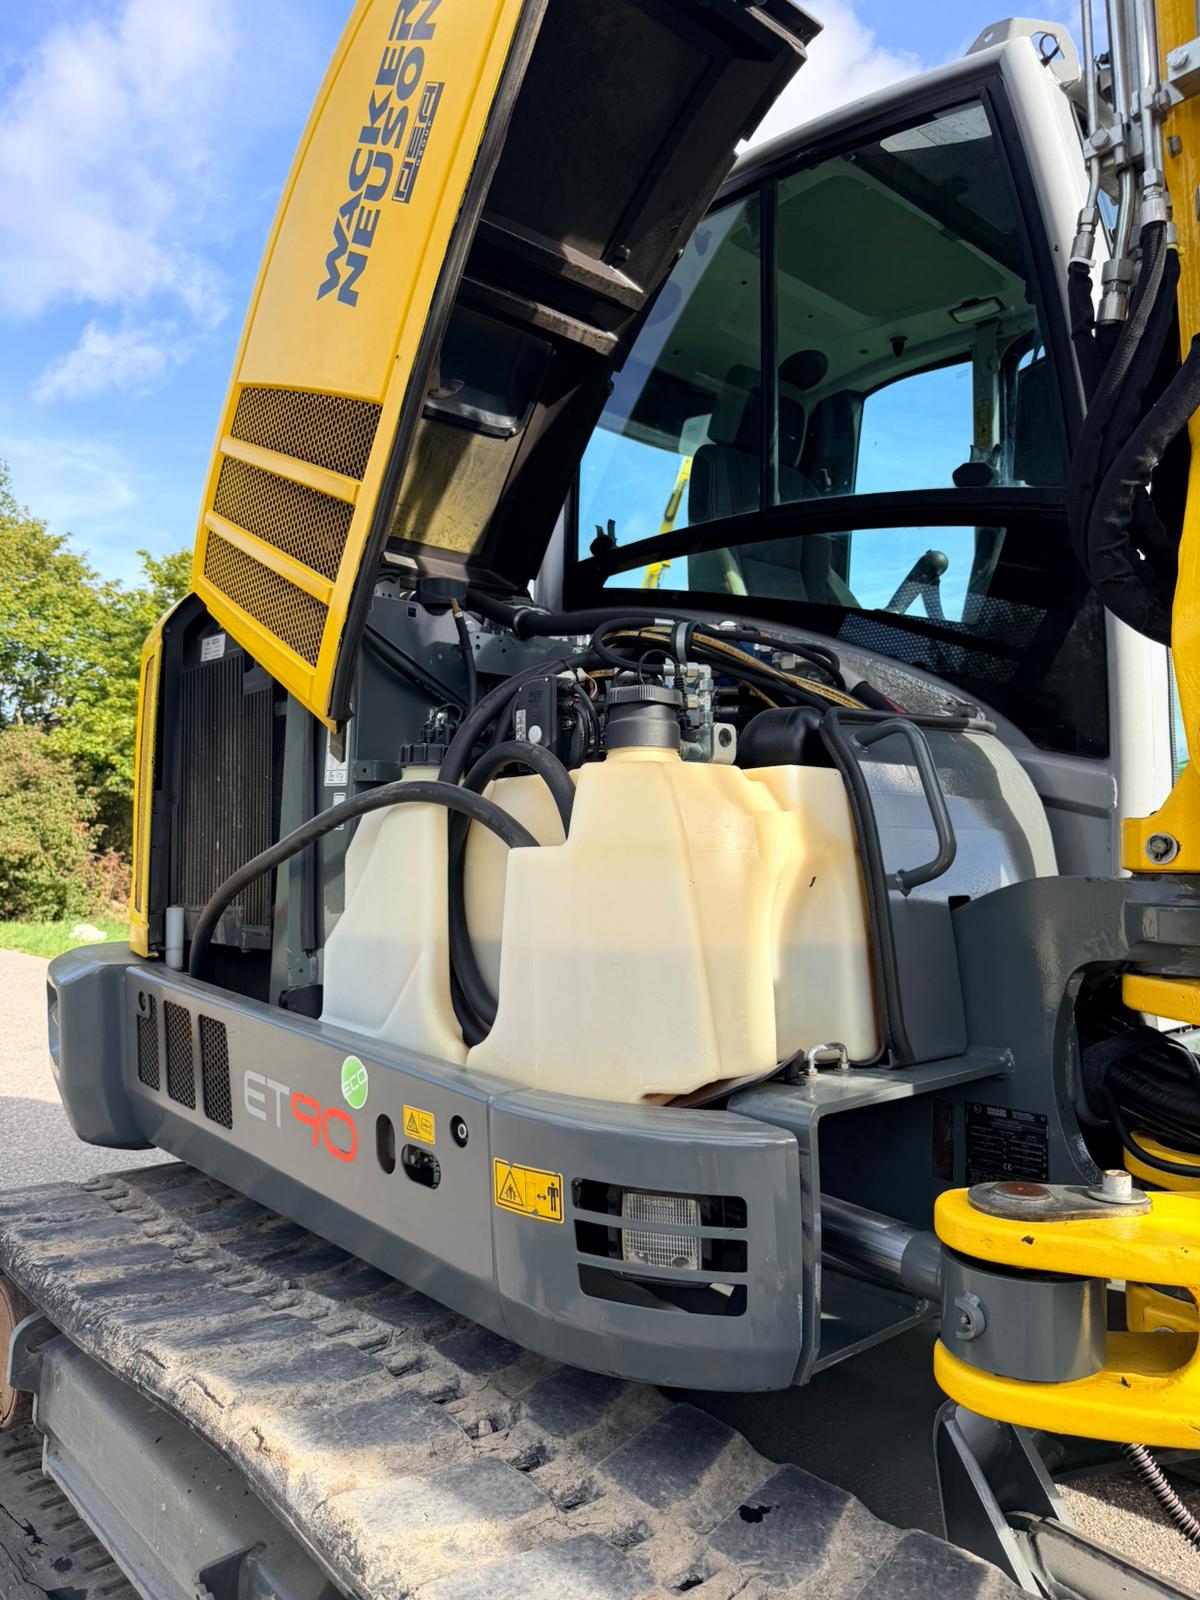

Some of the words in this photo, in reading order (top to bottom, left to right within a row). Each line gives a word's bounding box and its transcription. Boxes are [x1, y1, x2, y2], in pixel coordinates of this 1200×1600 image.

[316, 0, 419, 301] WACKER
[337, 0, 442, 307] NEUSON
[415, 120, 432, 167] GROUP
[244, 1069, 358, 1163] ET90
[342, 1066, 368, 1098] ECO
